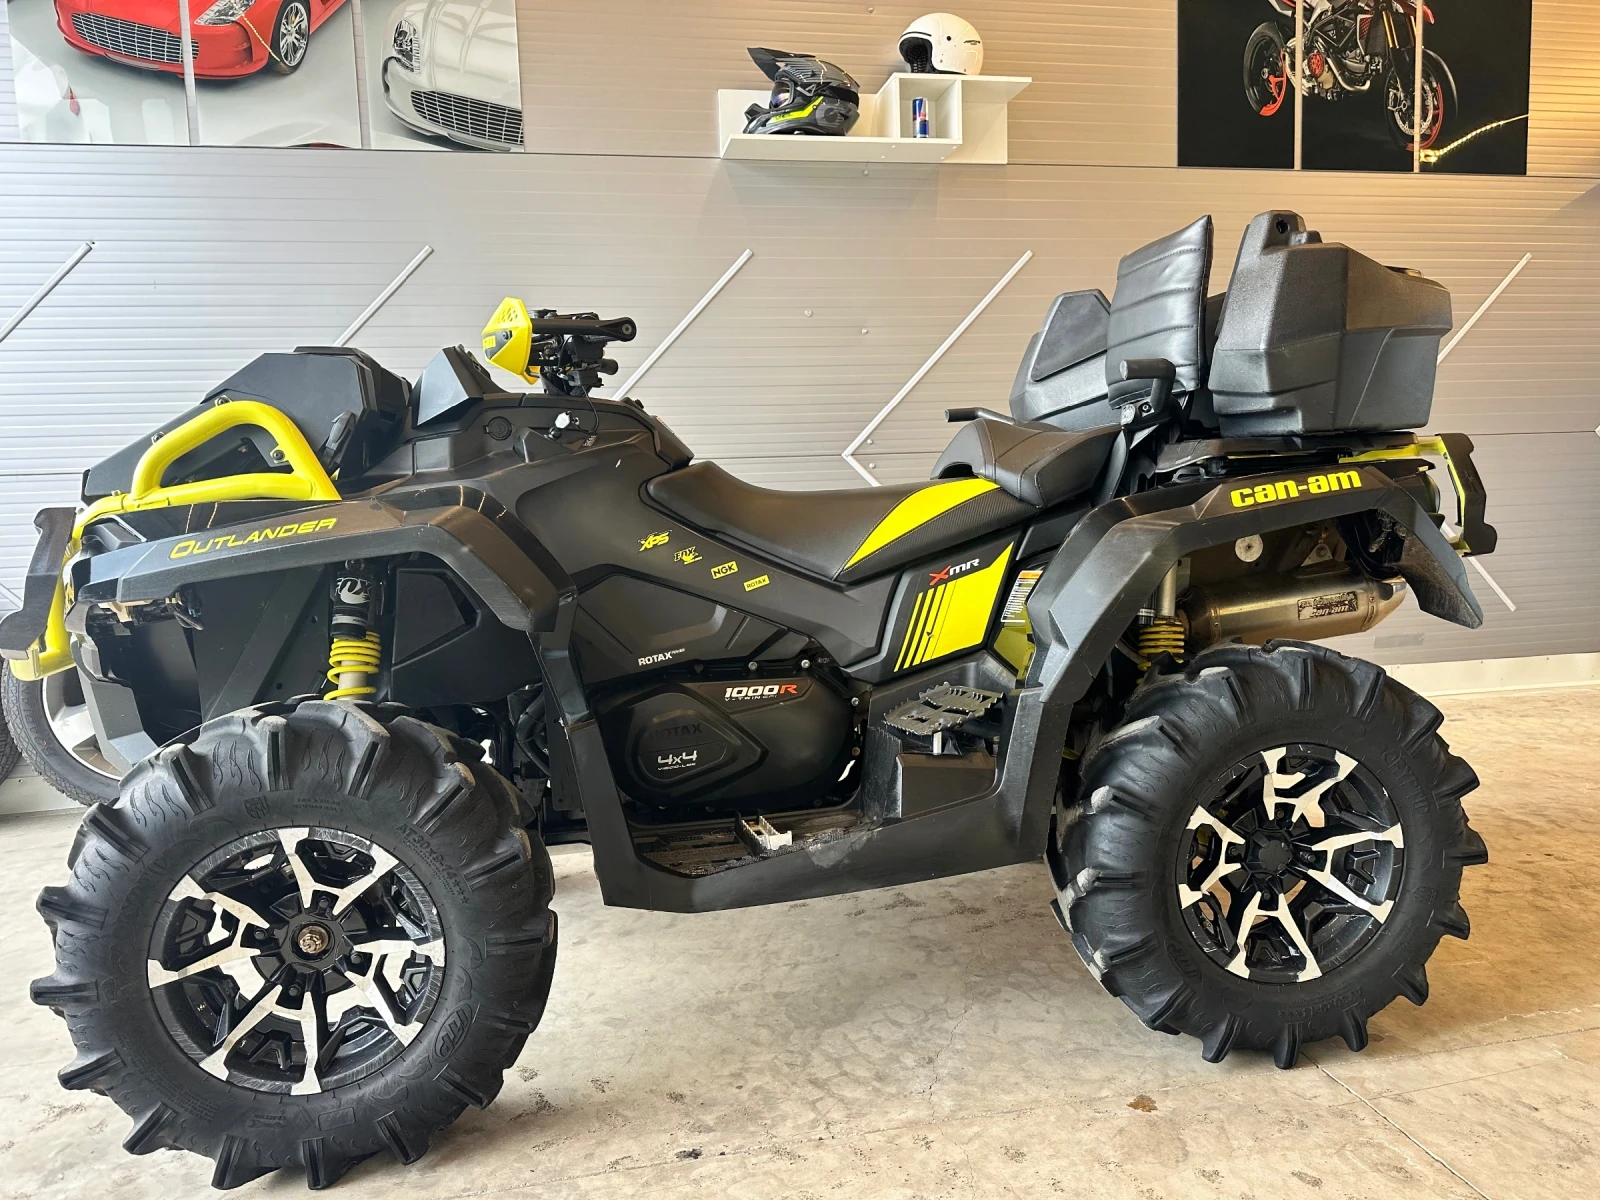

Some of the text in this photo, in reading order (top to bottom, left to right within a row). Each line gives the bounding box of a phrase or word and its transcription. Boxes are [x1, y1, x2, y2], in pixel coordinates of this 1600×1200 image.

[1230, 470, 1362, 508] can-am
[169, 517, 338, 559] OUTLANDER
[639, 530, 671, 551] XPS
[712, 563, 735, 578] NGK
[746, 578, 768, 590] ROTAX
[637, 651, 673, 666] ROTAX
[725, 684, 798, 698] 1000R
[657, 750, 698, 765] 4x4
